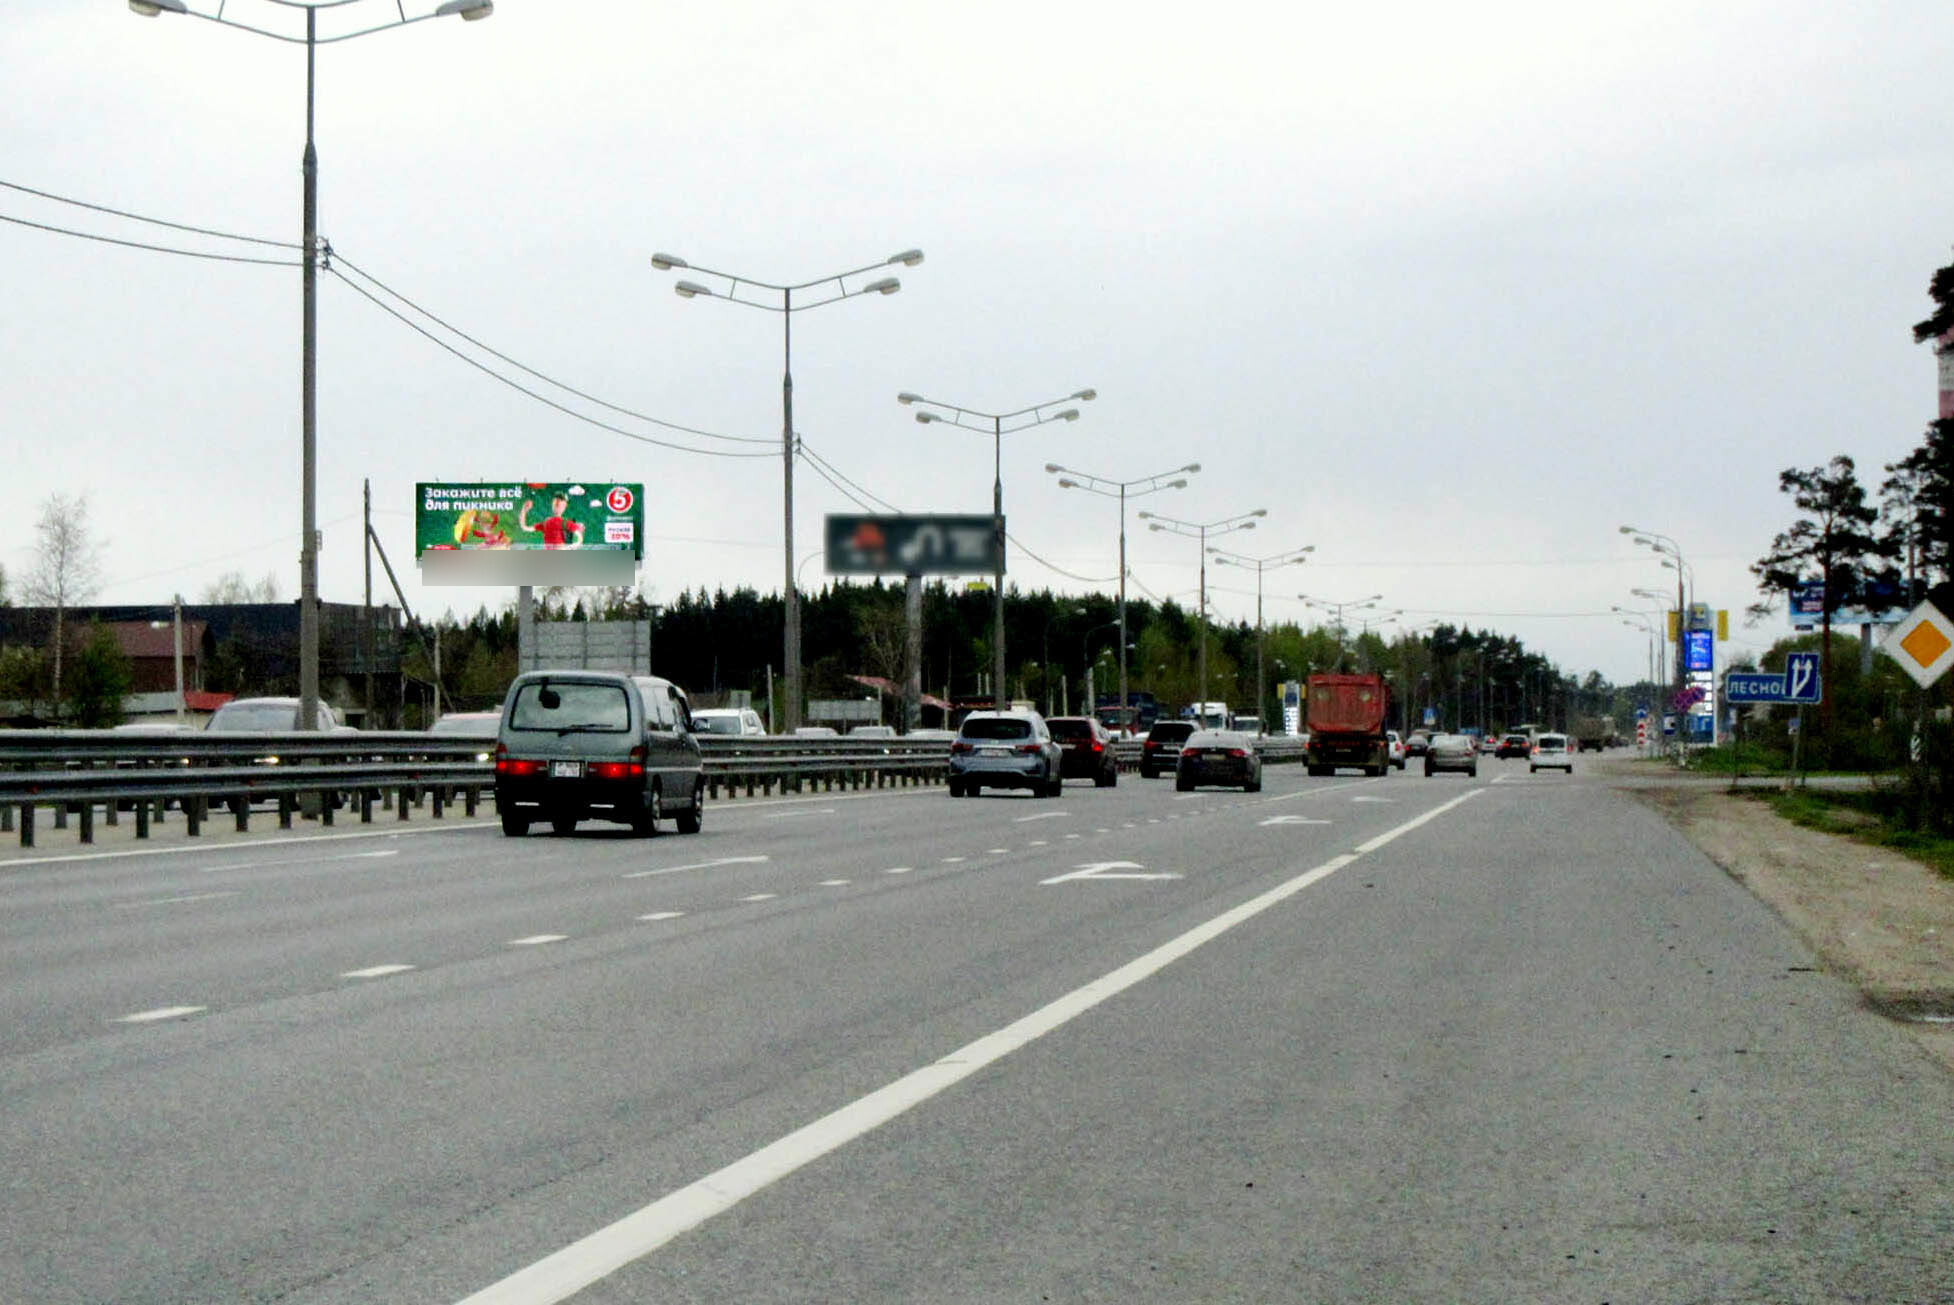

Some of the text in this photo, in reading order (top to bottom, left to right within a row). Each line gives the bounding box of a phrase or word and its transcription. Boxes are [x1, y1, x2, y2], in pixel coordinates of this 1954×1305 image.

[425, 486, 522, 498] Закажите всё
[425, 499, 513, 511] для пикника
[1728, 681, 1785, 695] ЛЕСНО
